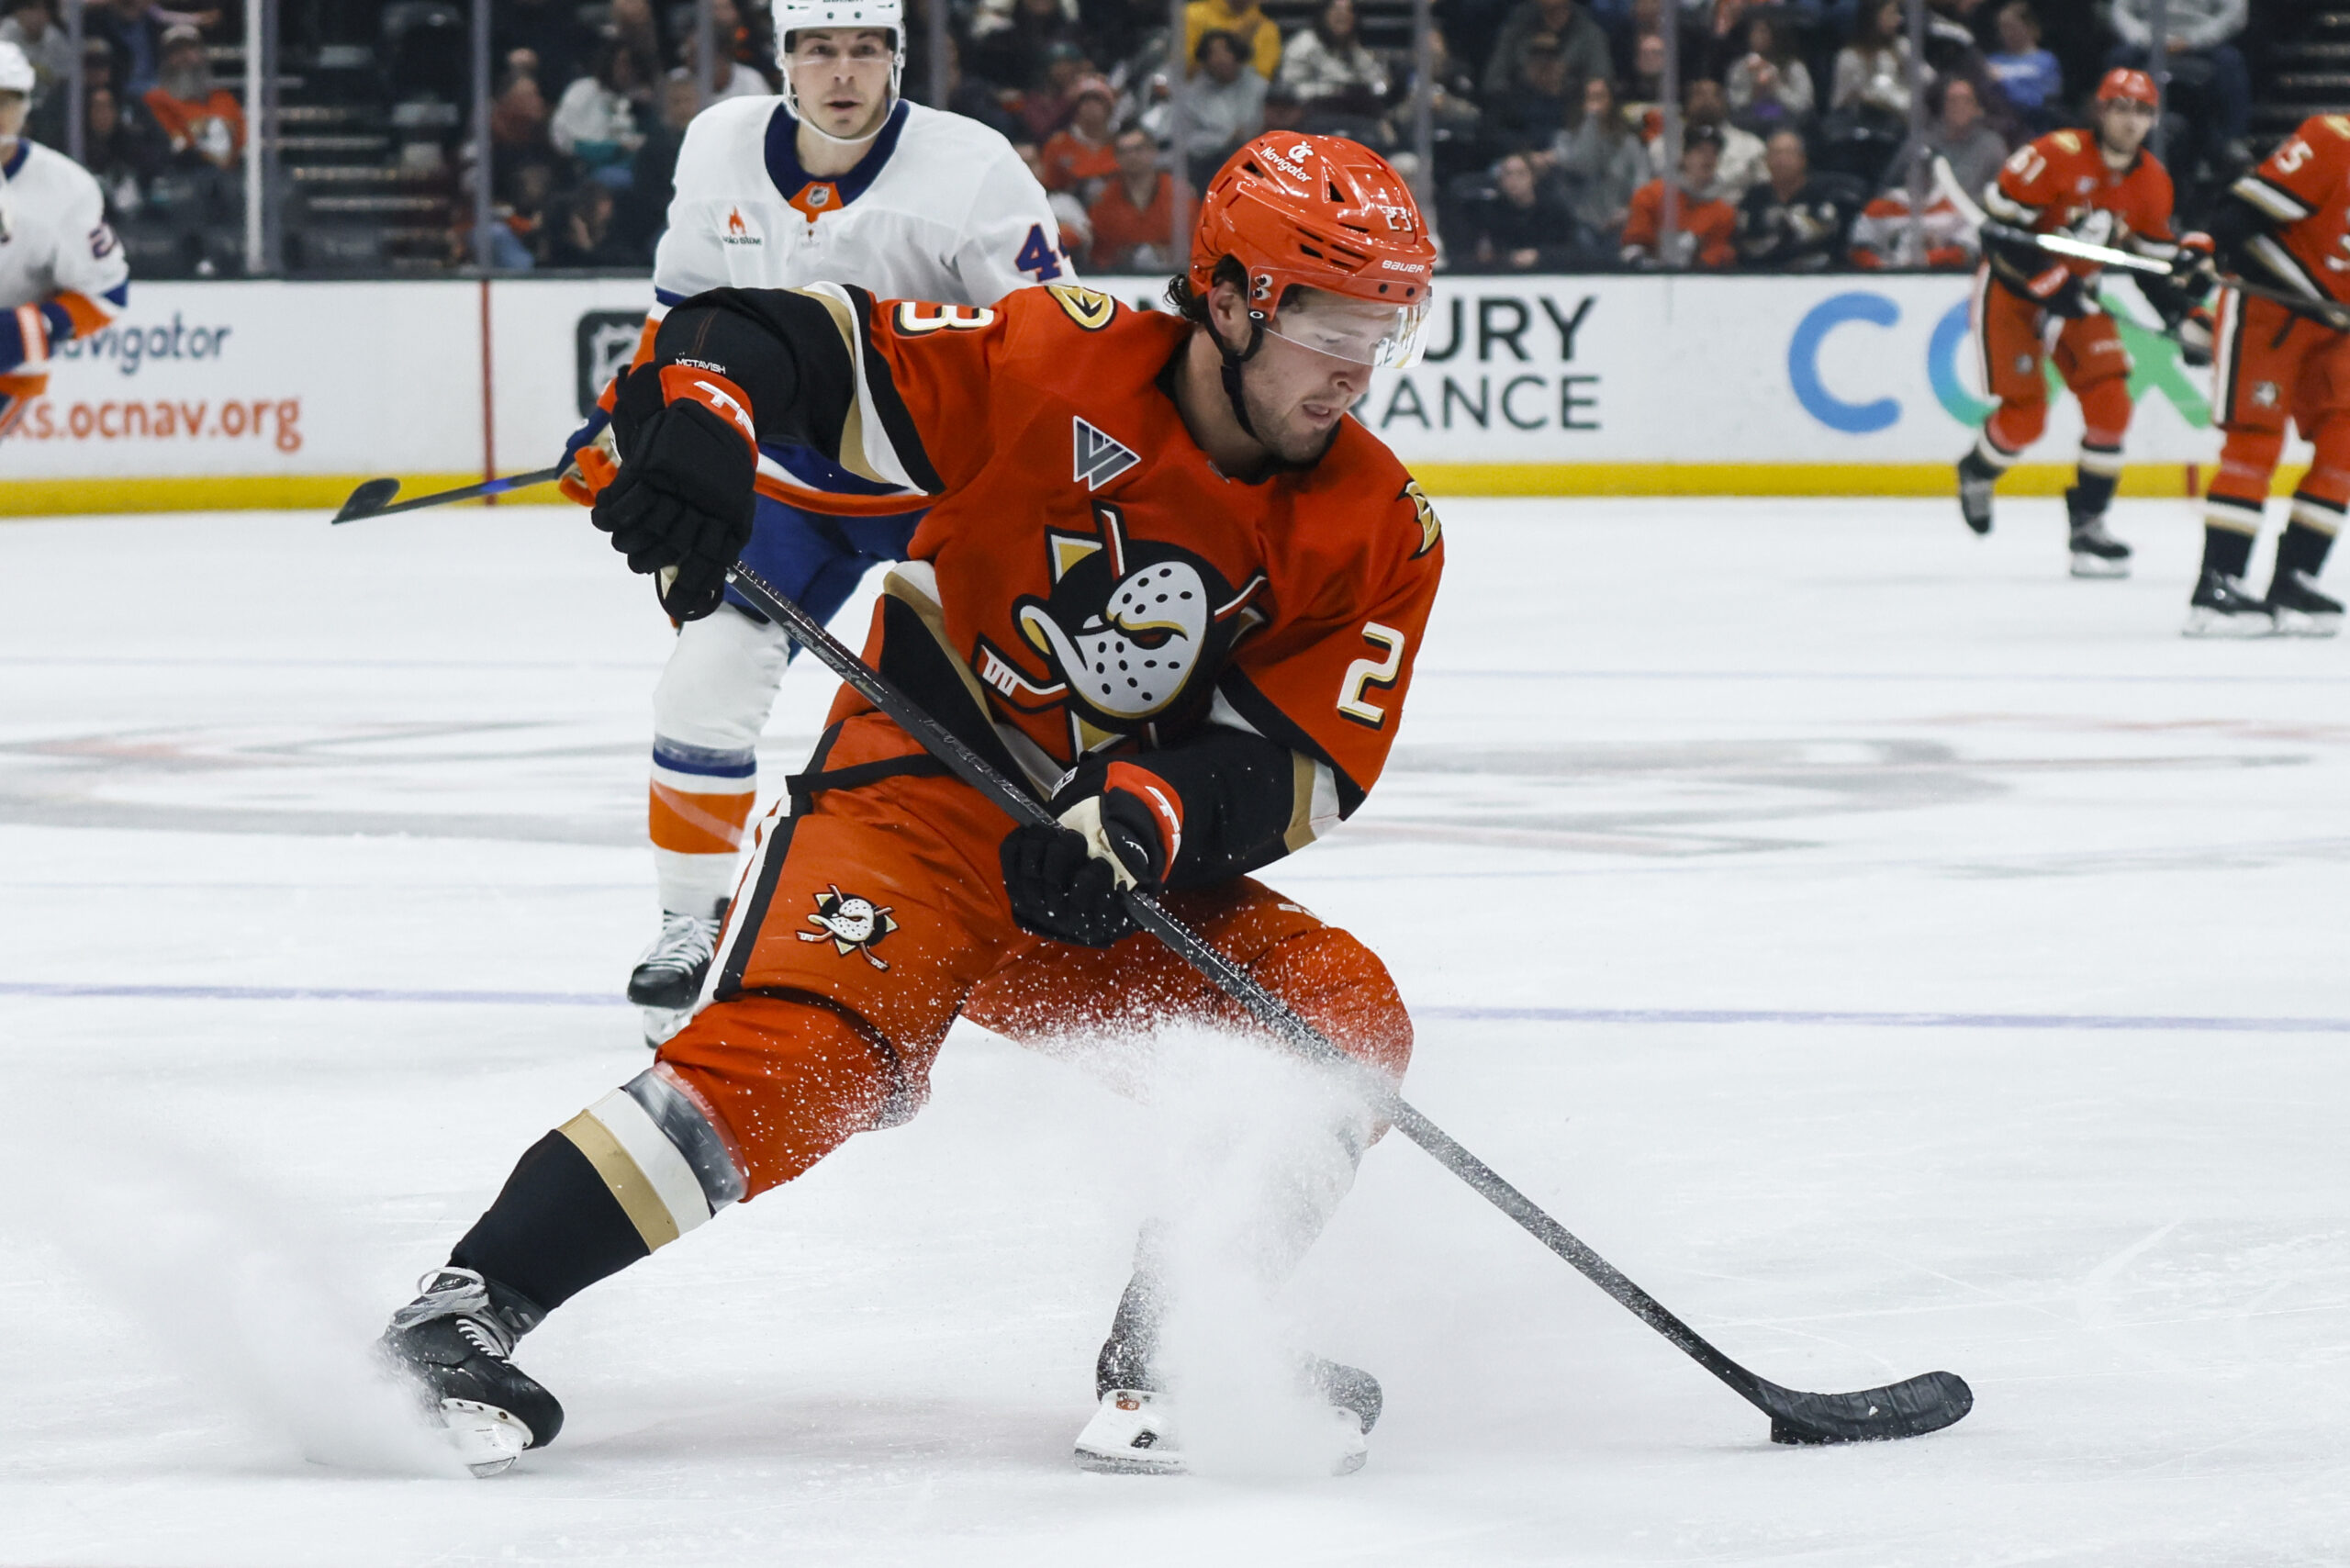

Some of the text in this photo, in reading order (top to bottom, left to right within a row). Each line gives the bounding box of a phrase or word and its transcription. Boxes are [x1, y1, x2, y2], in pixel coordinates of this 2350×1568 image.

[1260, 146, 1313, 183] Navigator
[2276, 139, 2313, 174] 5
[1014, 222, 1069, 284] 4
[1382, 259, 1426, 274] BAUER
[55, 310, 230, 375] avigator
[1423, 295, 1597, 364] URY
[676, 357, 727, 375] MCTAVISH
